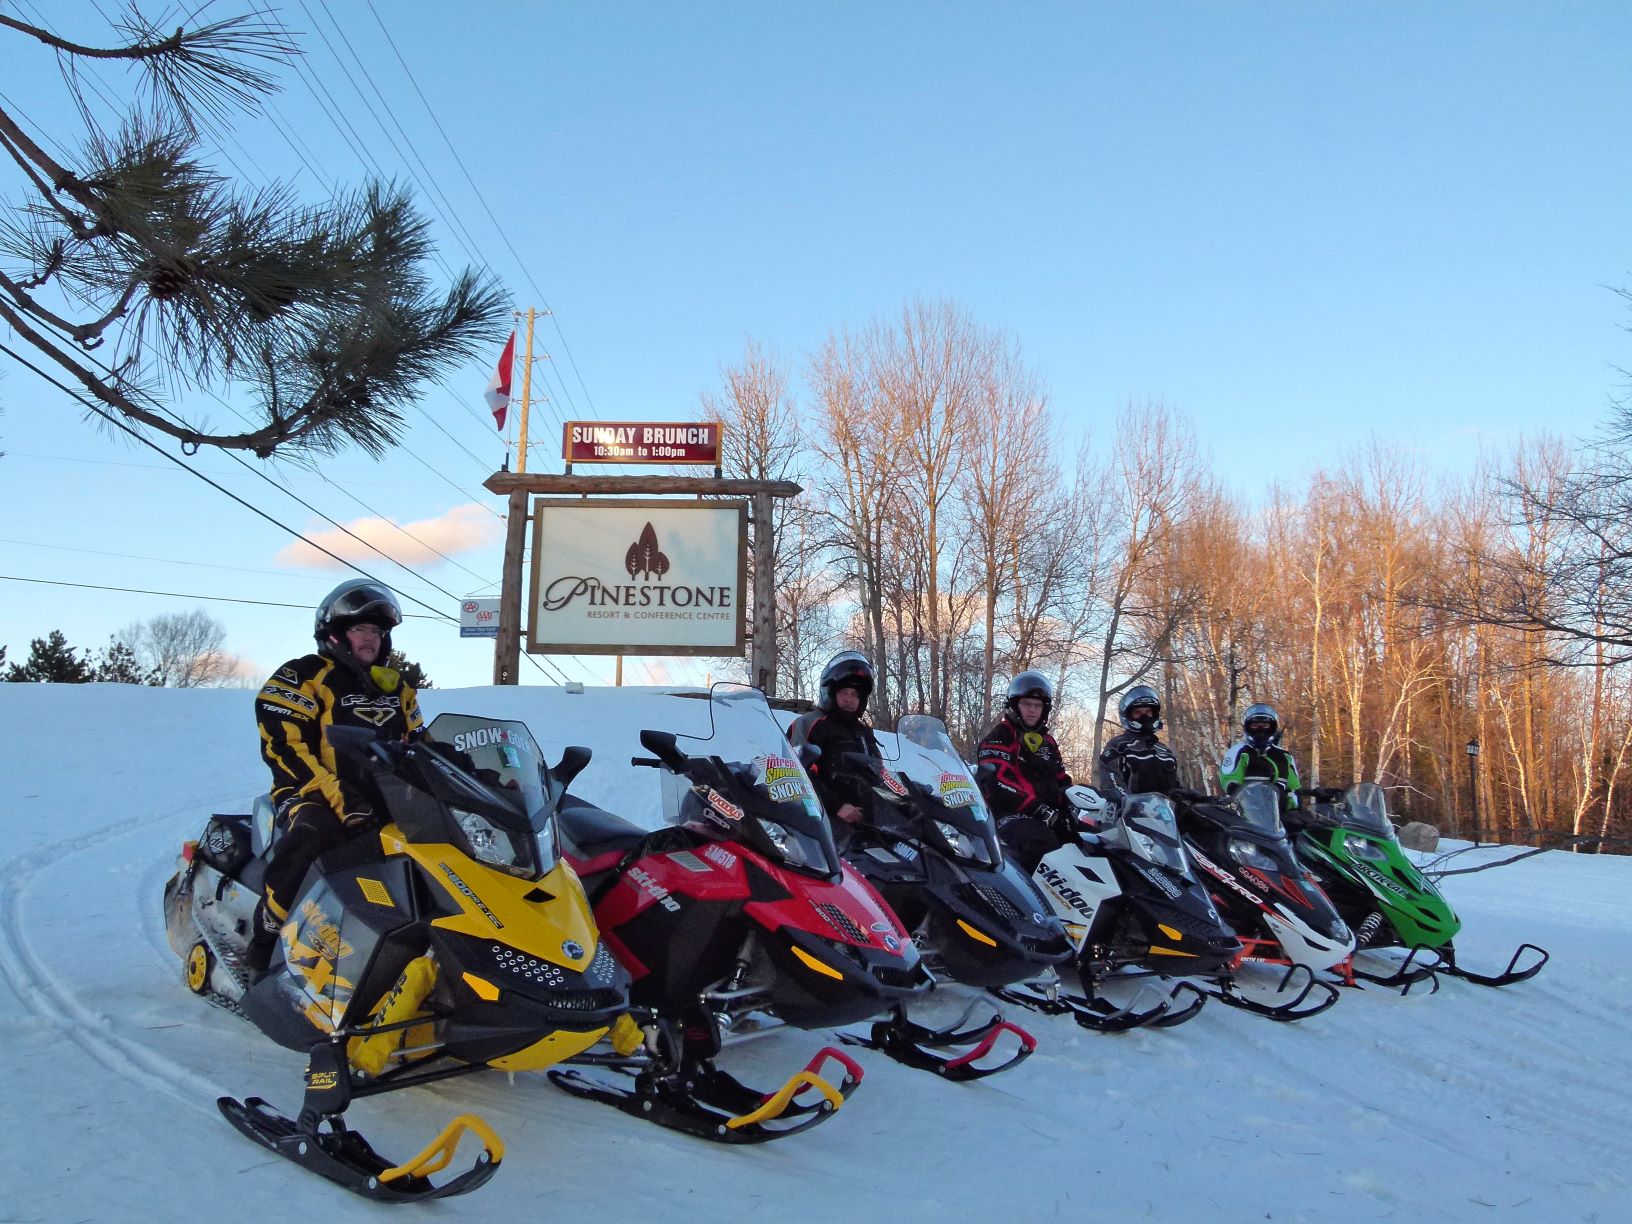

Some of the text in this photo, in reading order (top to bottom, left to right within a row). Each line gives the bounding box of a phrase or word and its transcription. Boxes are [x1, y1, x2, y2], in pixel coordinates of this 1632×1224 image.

[572, 426, 709, 445] SUNDAY BRUNCH
[594, 446, 686, 458] 10:30am to 1:00pm
[543, 576, 731, 611] PINESTONE
[587, 611, 730, 620] RESORT & CONFERENCE CENTRE
[262, 703, 292, 716] TEAM
[454, 727, 502, 752] SNOW
[769, 782, 803, 800] SNOW
[944, 792, 971, 806] SNOW
[627, 867, 681, 912] ski-doo
[1354, 863, 1409, 898] ARCTIC CAT
[1037, 863, 1094, 919] ski-doo
